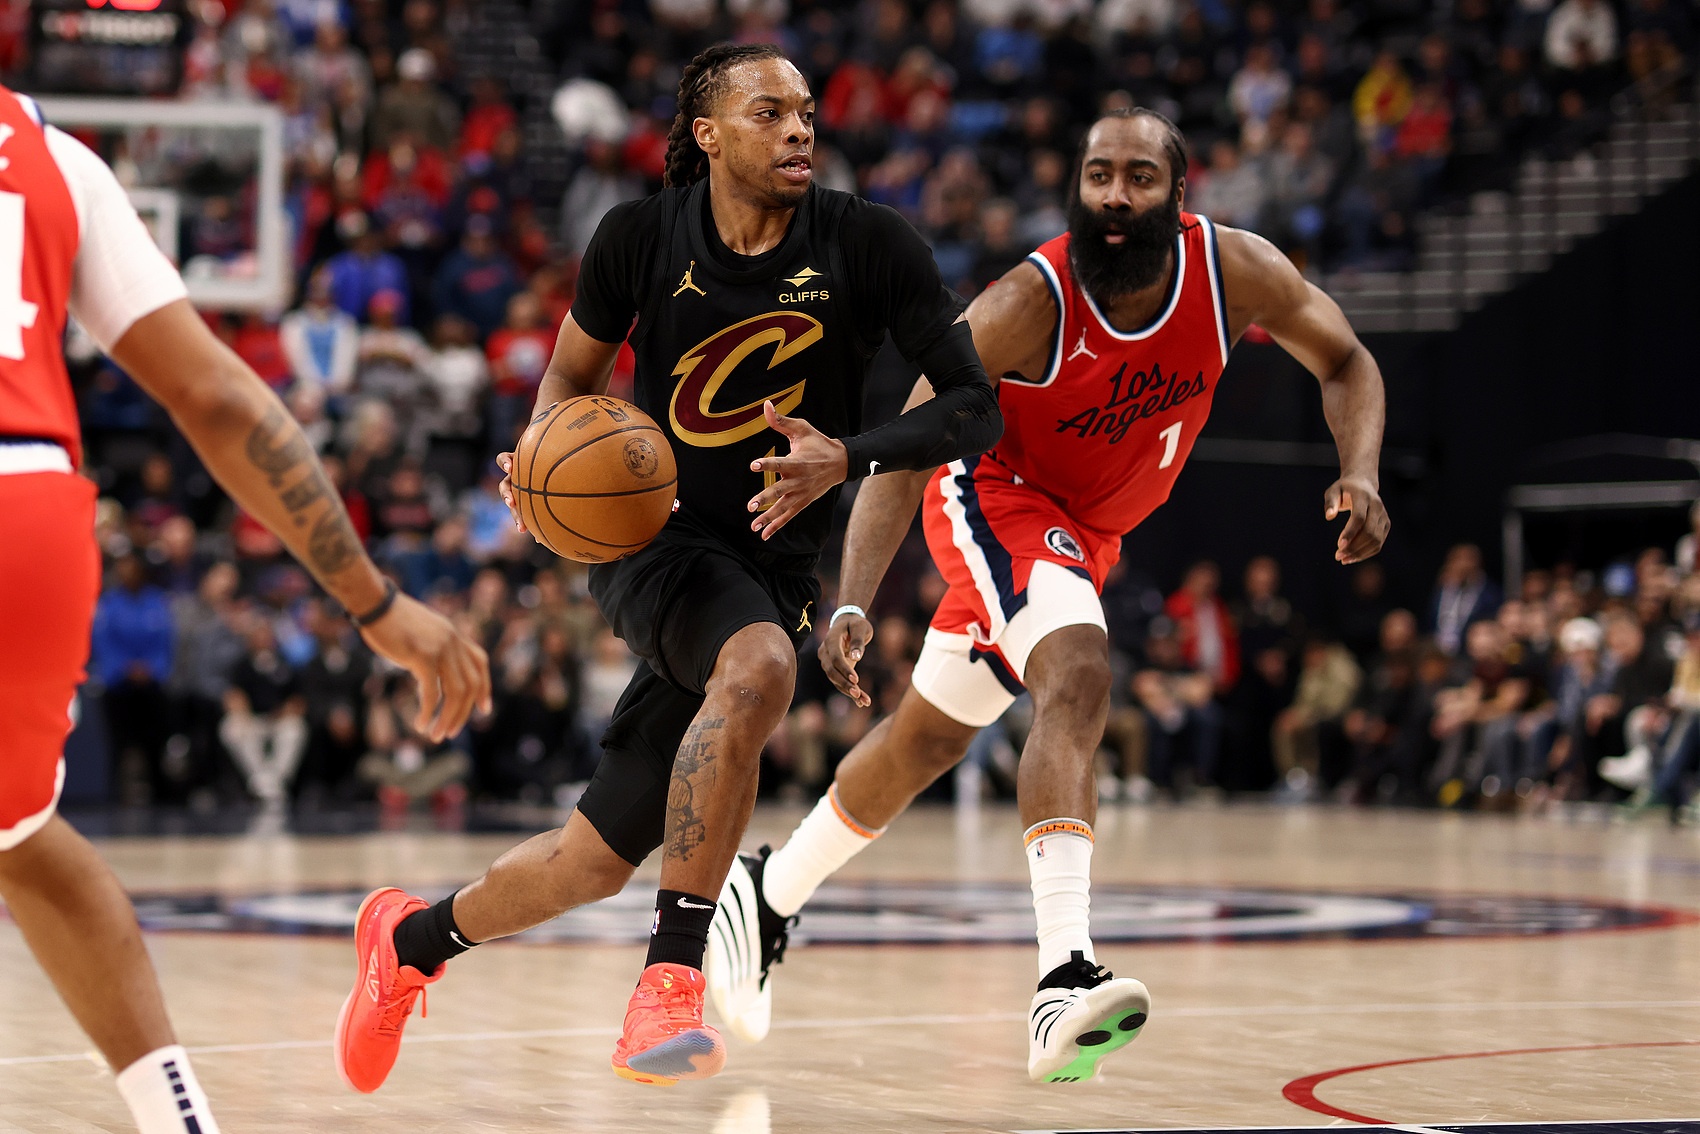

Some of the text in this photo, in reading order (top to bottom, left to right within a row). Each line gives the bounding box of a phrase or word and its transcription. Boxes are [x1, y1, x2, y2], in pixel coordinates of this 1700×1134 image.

[778, 290, 830, 304] CLIFFS
[669, 310, 824, 448] C
[1105, 361, 1168, 411] Los
[1055, 370, 1208, 445] Angeles
[1158, 420, 1183, 470] 1
